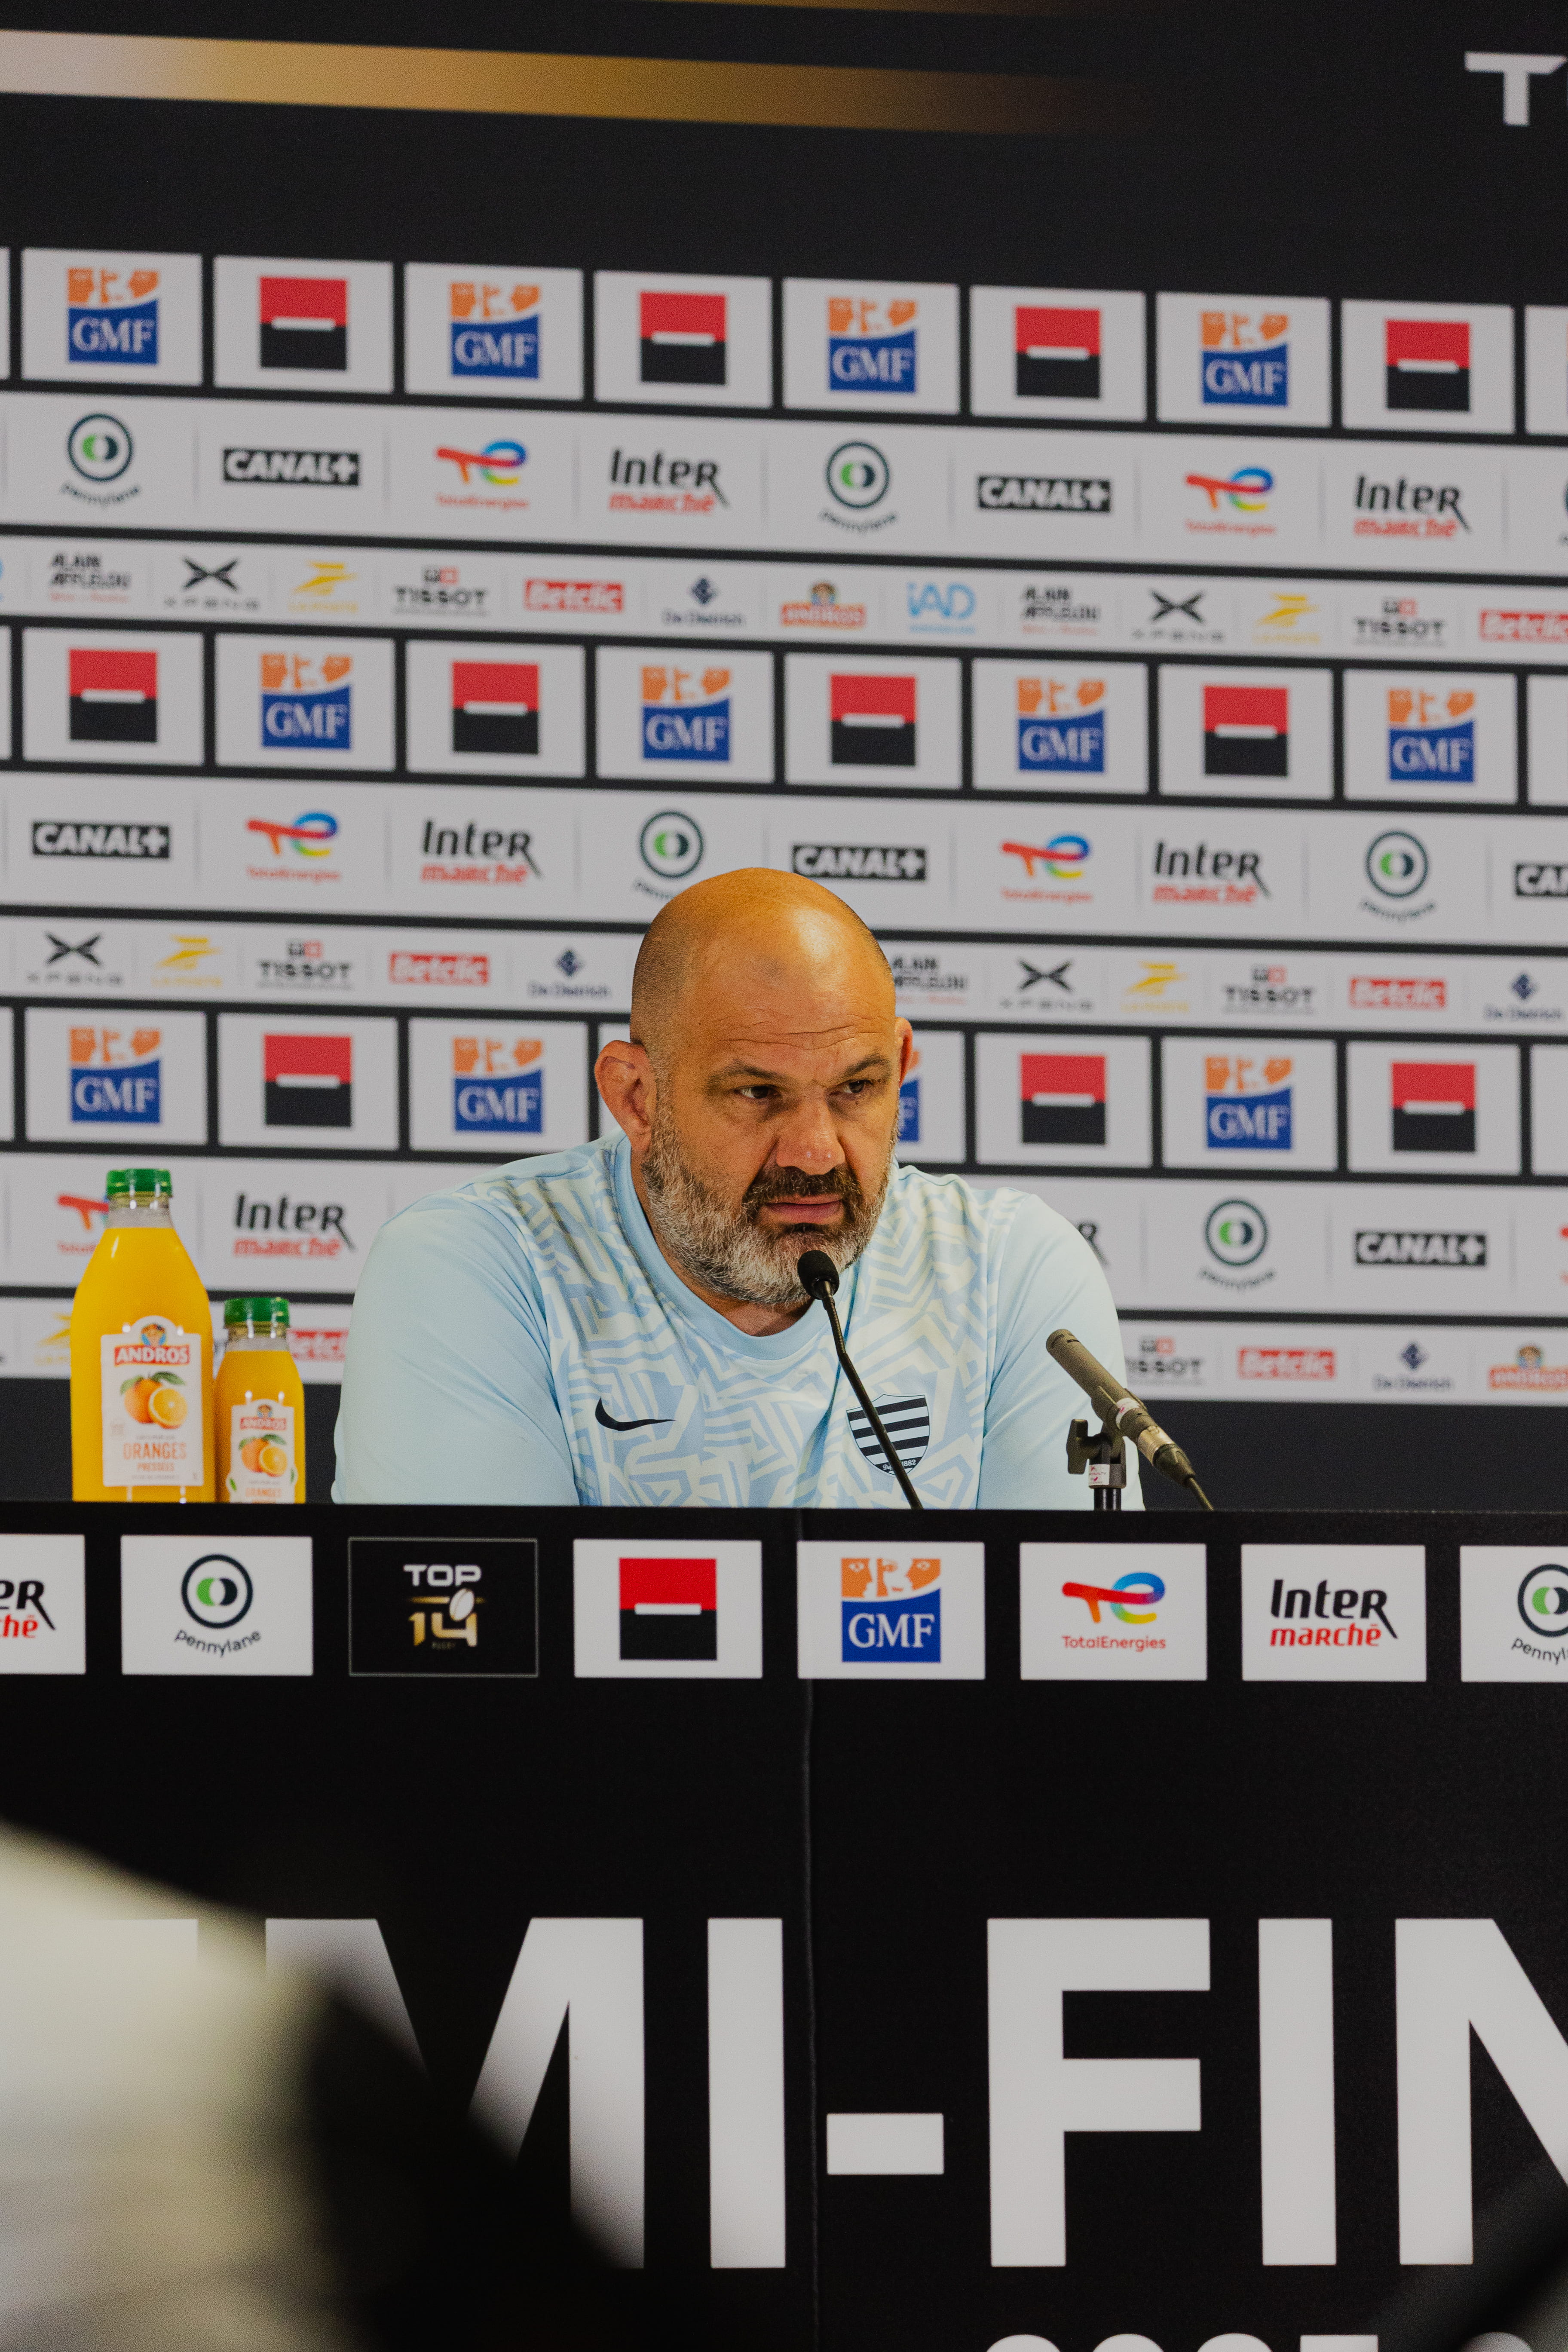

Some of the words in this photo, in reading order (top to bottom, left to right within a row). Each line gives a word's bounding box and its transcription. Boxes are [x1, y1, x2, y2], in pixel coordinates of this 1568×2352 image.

[1465, 51, 1568, 126] T
[71, 316, 156, 354] GMF
[454, 331, 537, 368] GMF
[832, 346, 914, 383] GMF
[1205, 359, 1286, 395] GMF
[224, 450, 359, 485] CANAL+
[980, 478, 1110, 510] CANAL+
[395, 587, 487, 605] TISSOT
[1355, 618, 1445, 638] TISSOT
[265, 702, 348, 739] GMF
[645, 714, 729, 751] GMF
[1020, 726, 1102, 763] GMF
[1391, 737, 1473, 774] GMF
[34, 823, 170, 858] CANAL+
[793, 845, 926, 880] CANAL+
[259, 961, 351, 980] TISSOT
[1224, 986, 1314, 1005] TISSOT
[74, 1077, 158, 1113] GMF
[457, 1087, 541, 1124] GMF
[1209, 1105, 1290, 1141] GMF
[1356, 1232, 1485, 1265] CANAL+
[116, 1347, 189, 1363] ANDROS
[123, 1442, 187, 1460] ORANGES
[403, 1564, 482, 1587] TOP
[408, 1612, 478, 1647] 14
[848, 1613, 935, 1648] GMF
[1061, 1635, 1166, 1653] TotalEnergies
[1510, 1637, 1568, 1665] pennyl
[99, 1917, 1568, 2269] MI-FIN
